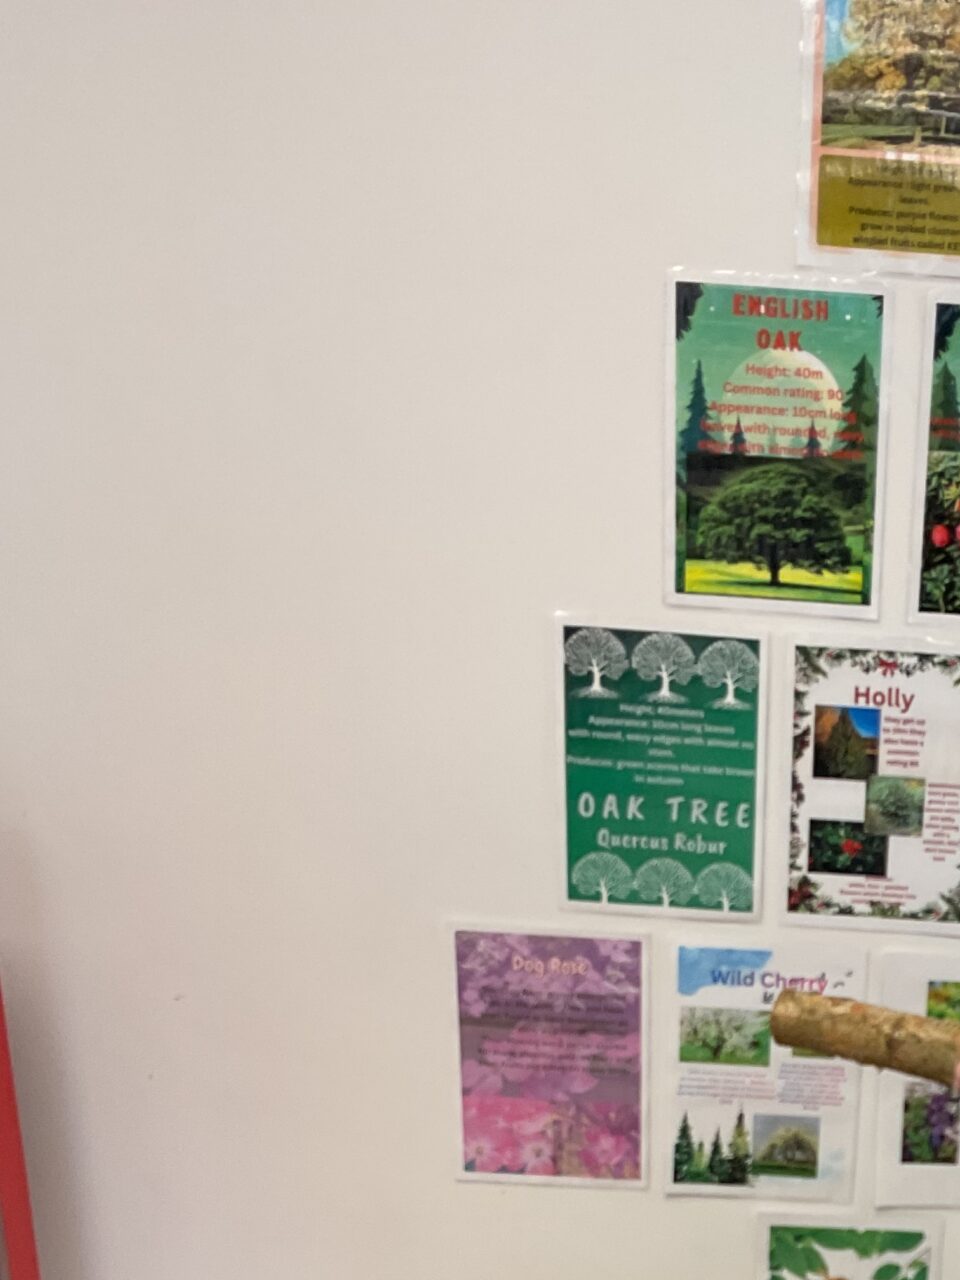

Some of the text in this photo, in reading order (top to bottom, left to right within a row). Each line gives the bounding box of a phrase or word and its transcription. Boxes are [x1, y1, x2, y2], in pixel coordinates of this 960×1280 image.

[732, 293, 829, 321] ENGLISH
[756, 328, 803, 352] OAK
[746, 363, 823, 379] Height: 40m
[723, 382, 843, 402] Common rating: 90
[709, 400, 789, 416] Appearance:
[793, 406, 826, 418] 10cm
[745, 422, 769, 434] with
[853, 685, 915, 713] Holly
[577, 792, 751, 829] OAK TREE
[597, 828, 727, 855] Quercus Robur
[512, 955, 587, 978] Dog Rose
[711, 969, 829, 996] Wild Cherry
